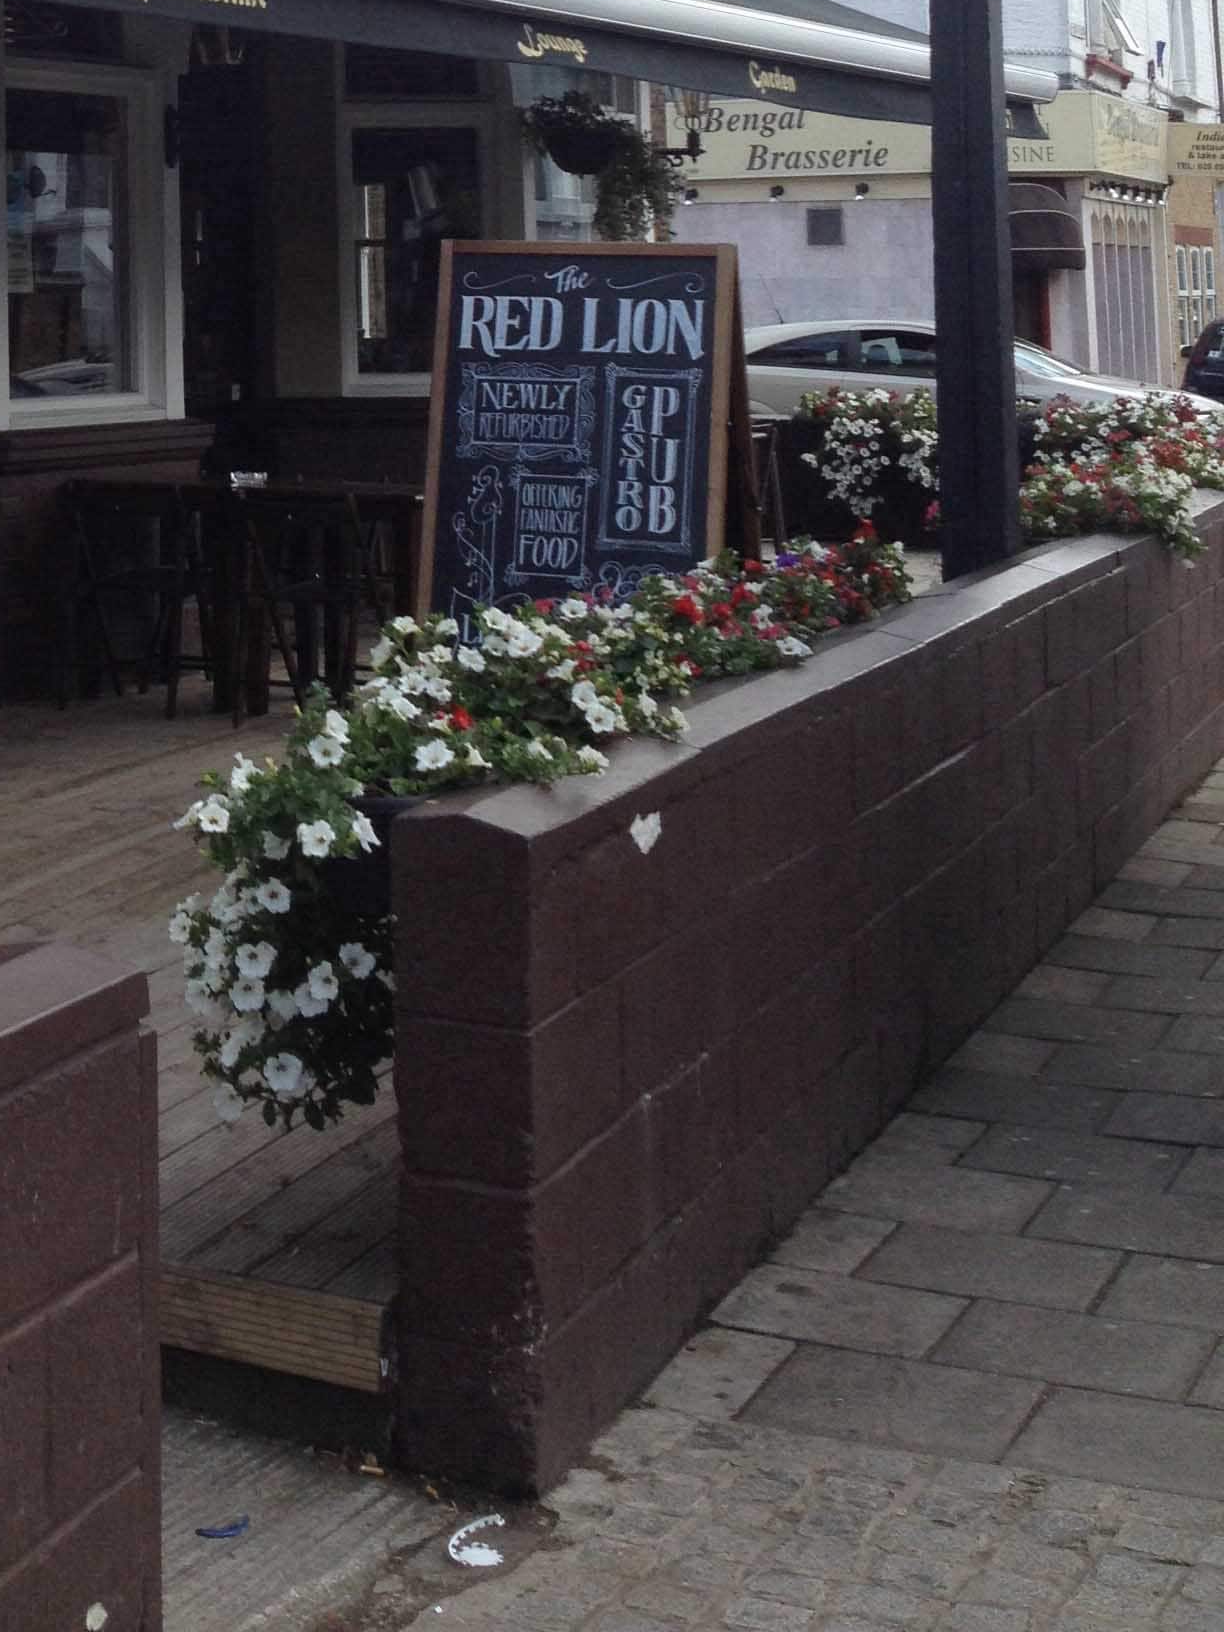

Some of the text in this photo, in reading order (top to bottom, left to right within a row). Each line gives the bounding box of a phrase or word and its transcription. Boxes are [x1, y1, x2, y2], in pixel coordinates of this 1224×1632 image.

[516, 22, 589, 63] Lounge
[748, 60, 798, 95] Garden
[703, 107, 807, 138] Bengal
[745, 139, 890, 172] Brasserie
[1010, 144, 1056, 164] SINE
[544, 265, 592, 294] The
[458, 295, 705, 361] RED LION
[480, 381, 573, 411] NEWLY
[478, 412, 570, 441] REFURBISHED
[615, 384, 649, 532] GASTRO
[647, 385, 681, 535] PUB
[521, 482, 583, 509] OFFERING
[519, 508, 581, 535] FANTASTIC
[518, 533, 579, 570] FOOD
